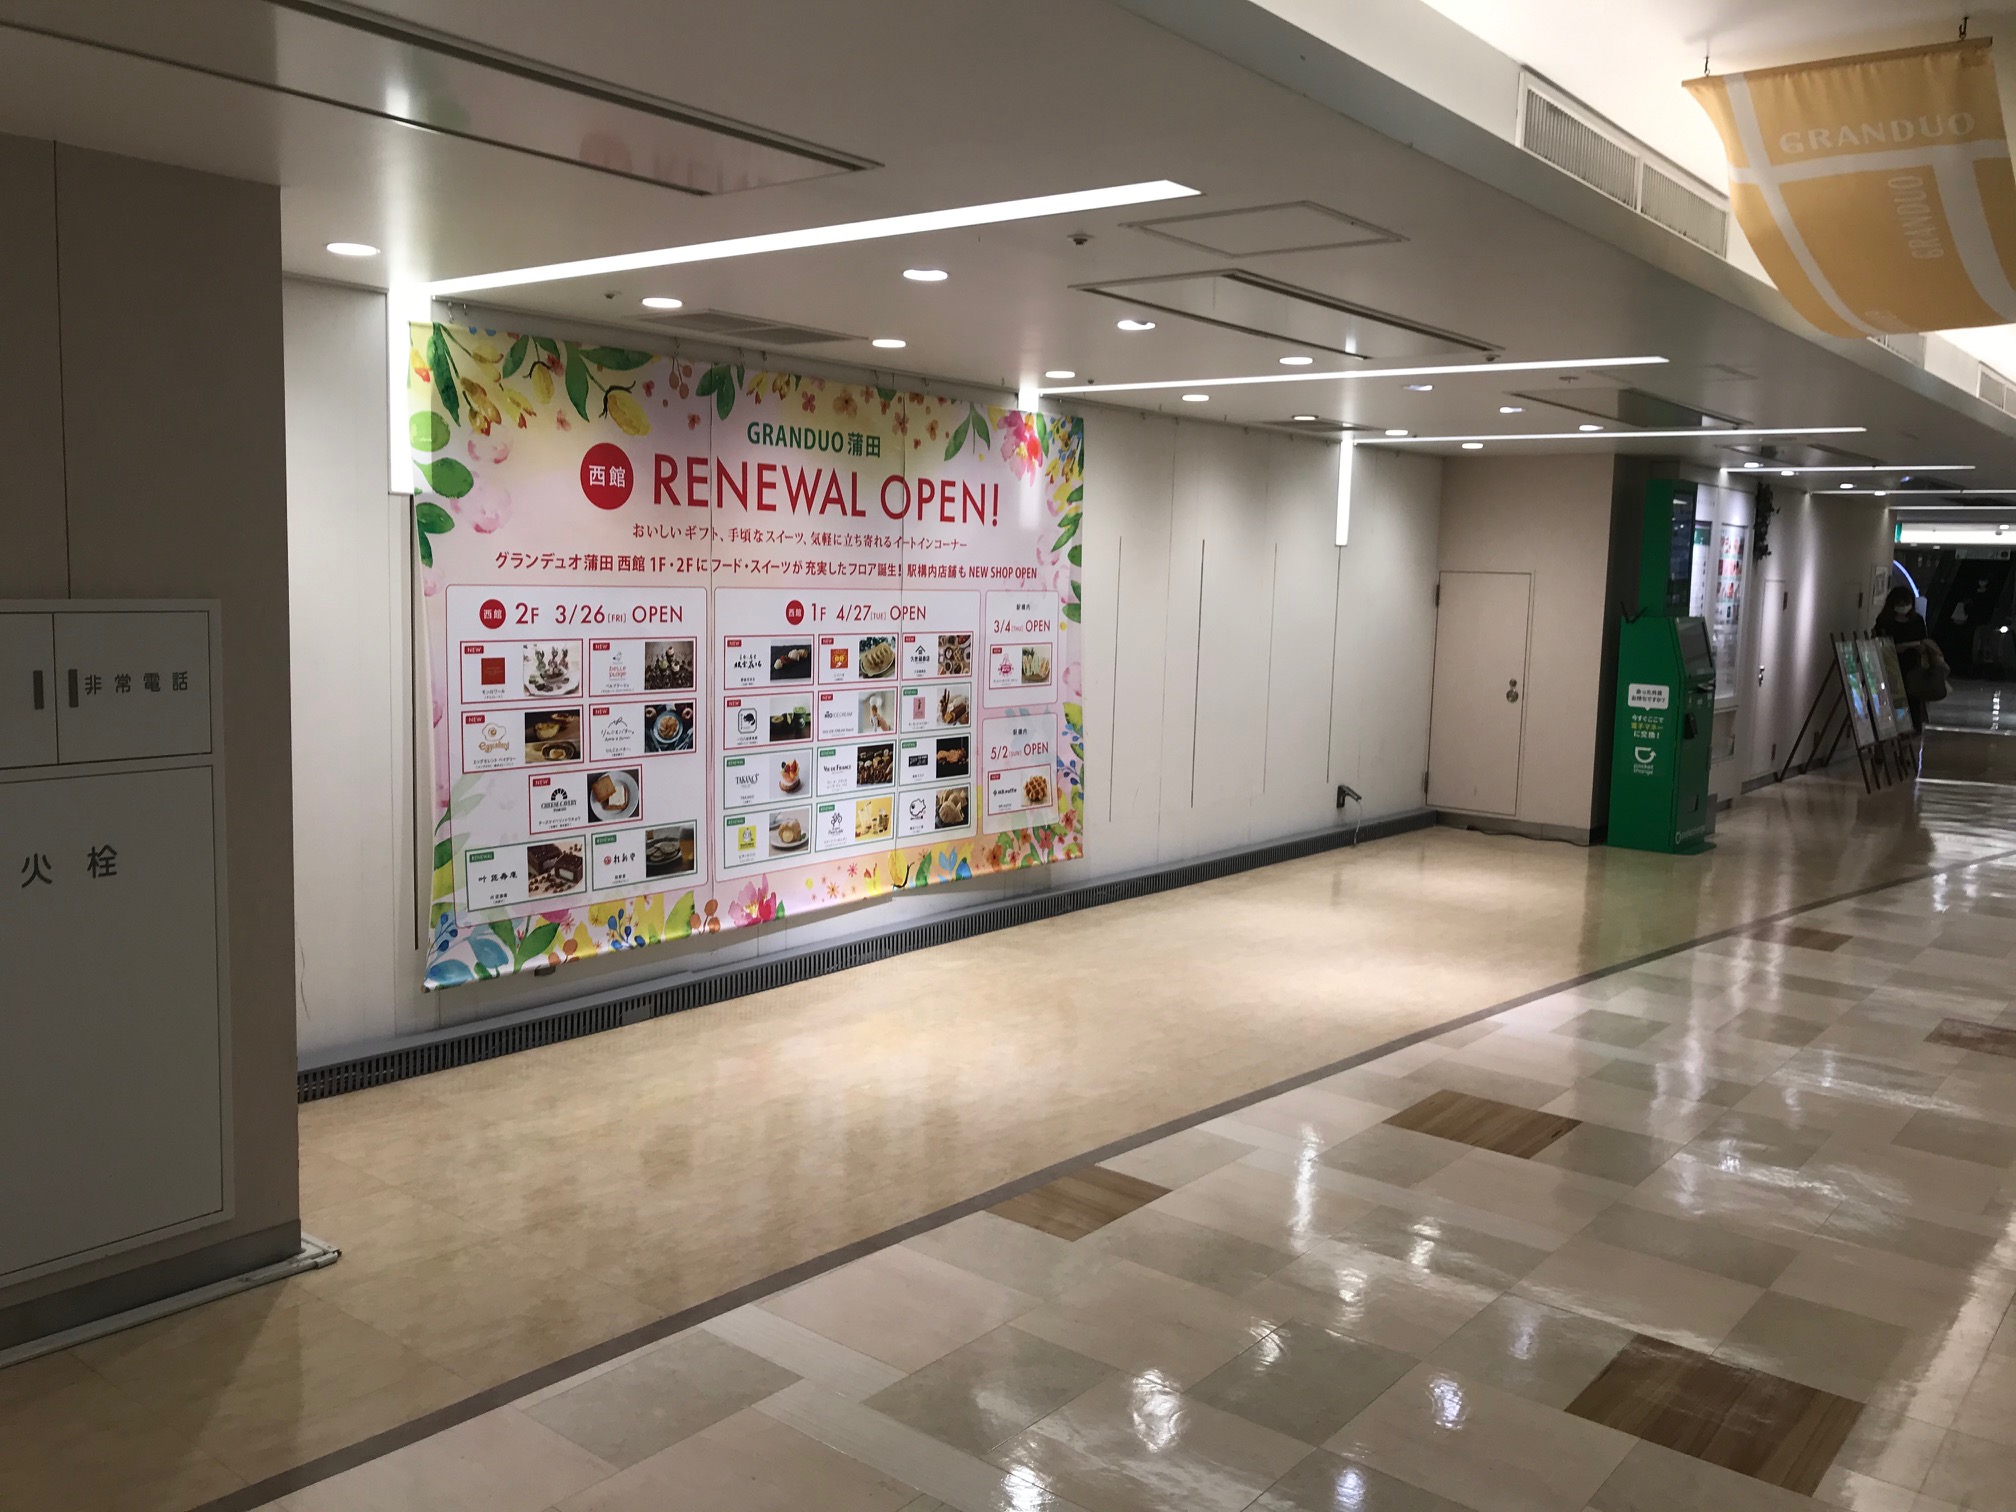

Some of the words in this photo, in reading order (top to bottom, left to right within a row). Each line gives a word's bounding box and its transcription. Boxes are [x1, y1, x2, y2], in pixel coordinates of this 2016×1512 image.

[1779, 112, 1975, 155] GRANDUO
[1887, 175, 1944, 260] GRANDUO
[589, 464, 627, 488] 西館
[653, 453, 867, 518] RENEWAL
[879, 474, 999, 528] OPEN!
[968, 566, 988, 579] NEW
[990, 566, 1014, 580] SHOP
[1015, 567, 1038, 580] OPEN
[514, 602, 540, 625] 2F
[631, 605, 683, 624] OPEN
[811, 603, 827, 622] 1F
[889, 605, 927, 621] OPEN
[1025, 619, 1051, 633] OPEN
[84, 670, 189, 696] 非常電話
[1023, 742, 1049, 756] OPEN
